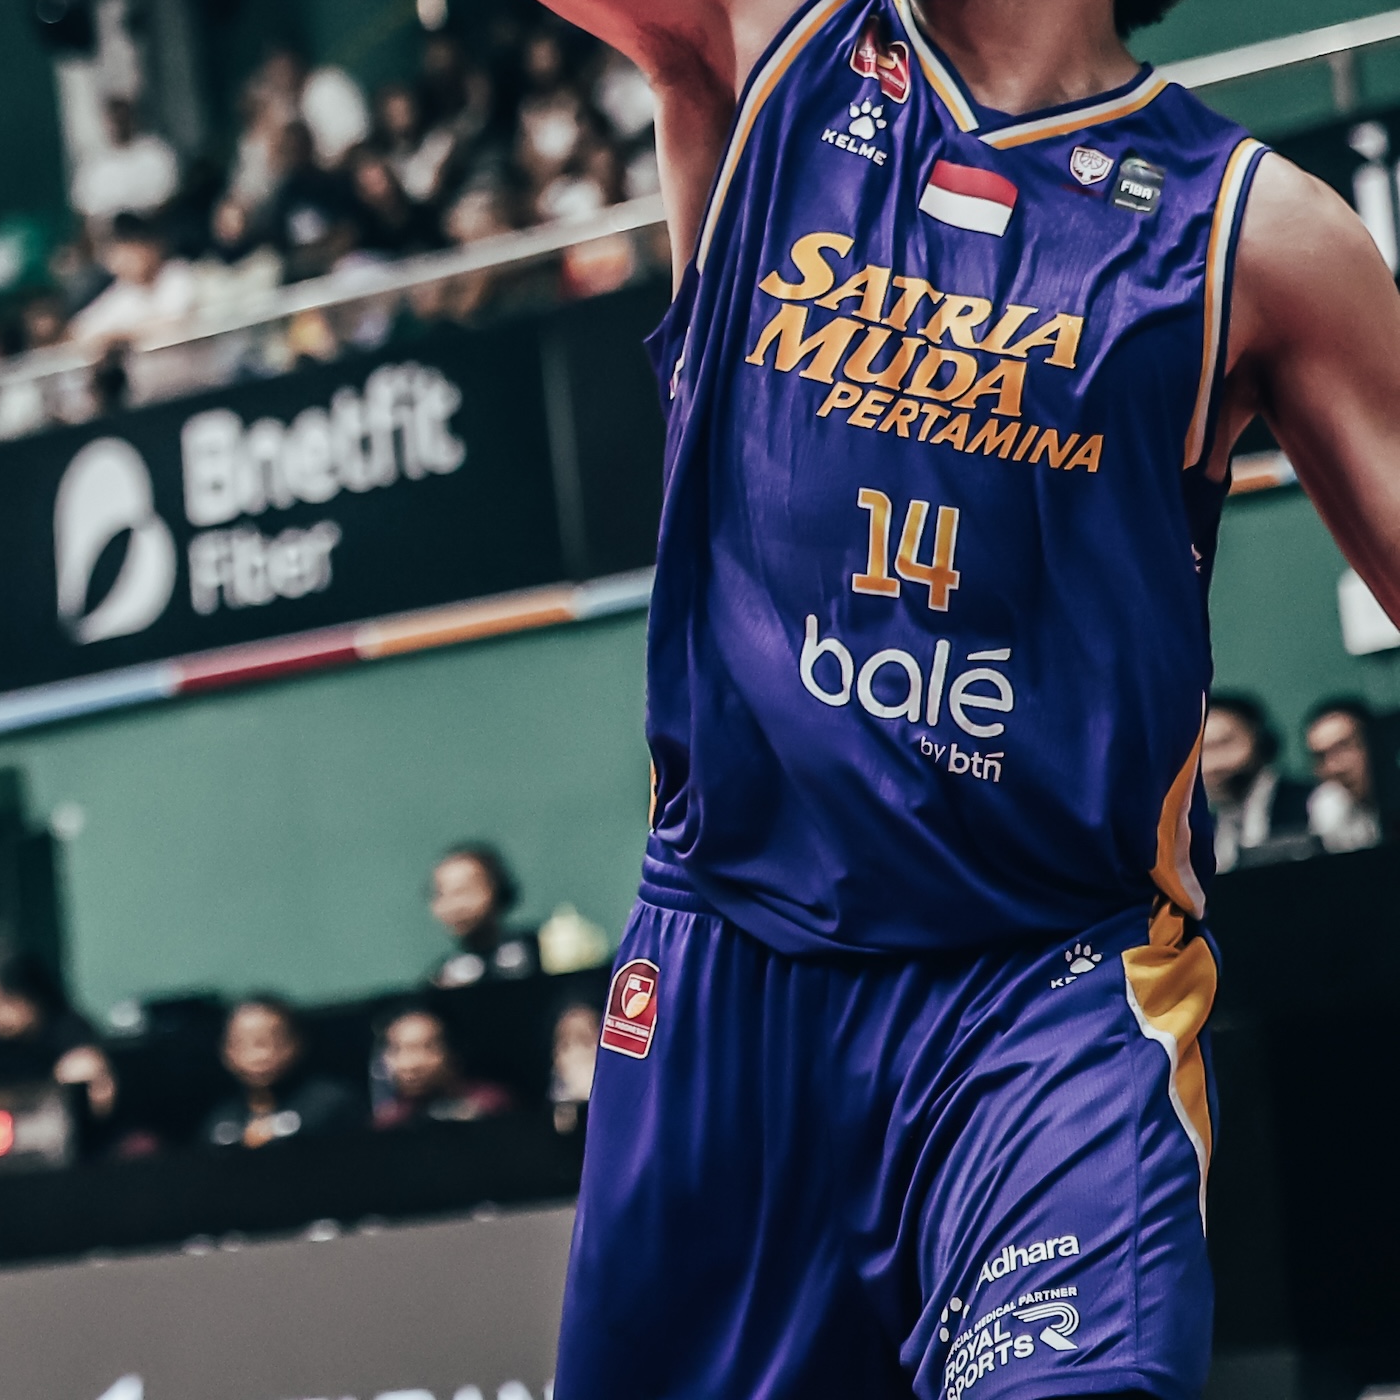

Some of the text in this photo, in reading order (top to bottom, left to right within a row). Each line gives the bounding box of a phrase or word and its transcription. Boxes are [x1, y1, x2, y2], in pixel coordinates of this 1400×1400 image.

[821, 126, 887, 166] KELME
[1120, 179, 1154, 200] FIBA
[757, 231, 1086, 369] SATRIA
[745, 304, 1028, 417] MUDA
[180, 359, 467, 527] Bnetfit
[816, 380, 1104, 473] PERTAMINA
[187, 519, 343, 616] Fiber
[851, 487, 961, 613] 14
[919, 734, 947, 763] by
[975, 1234, 1080, 1291] Adhara
[974, 1301, 1017, 1334] MEDICAL
[1018, 1286, 1078, 1306] PARTNER
[944, 1319, 1011, 1389] ROYAL
[946, 1334, 1035, 1400] SPORTS
